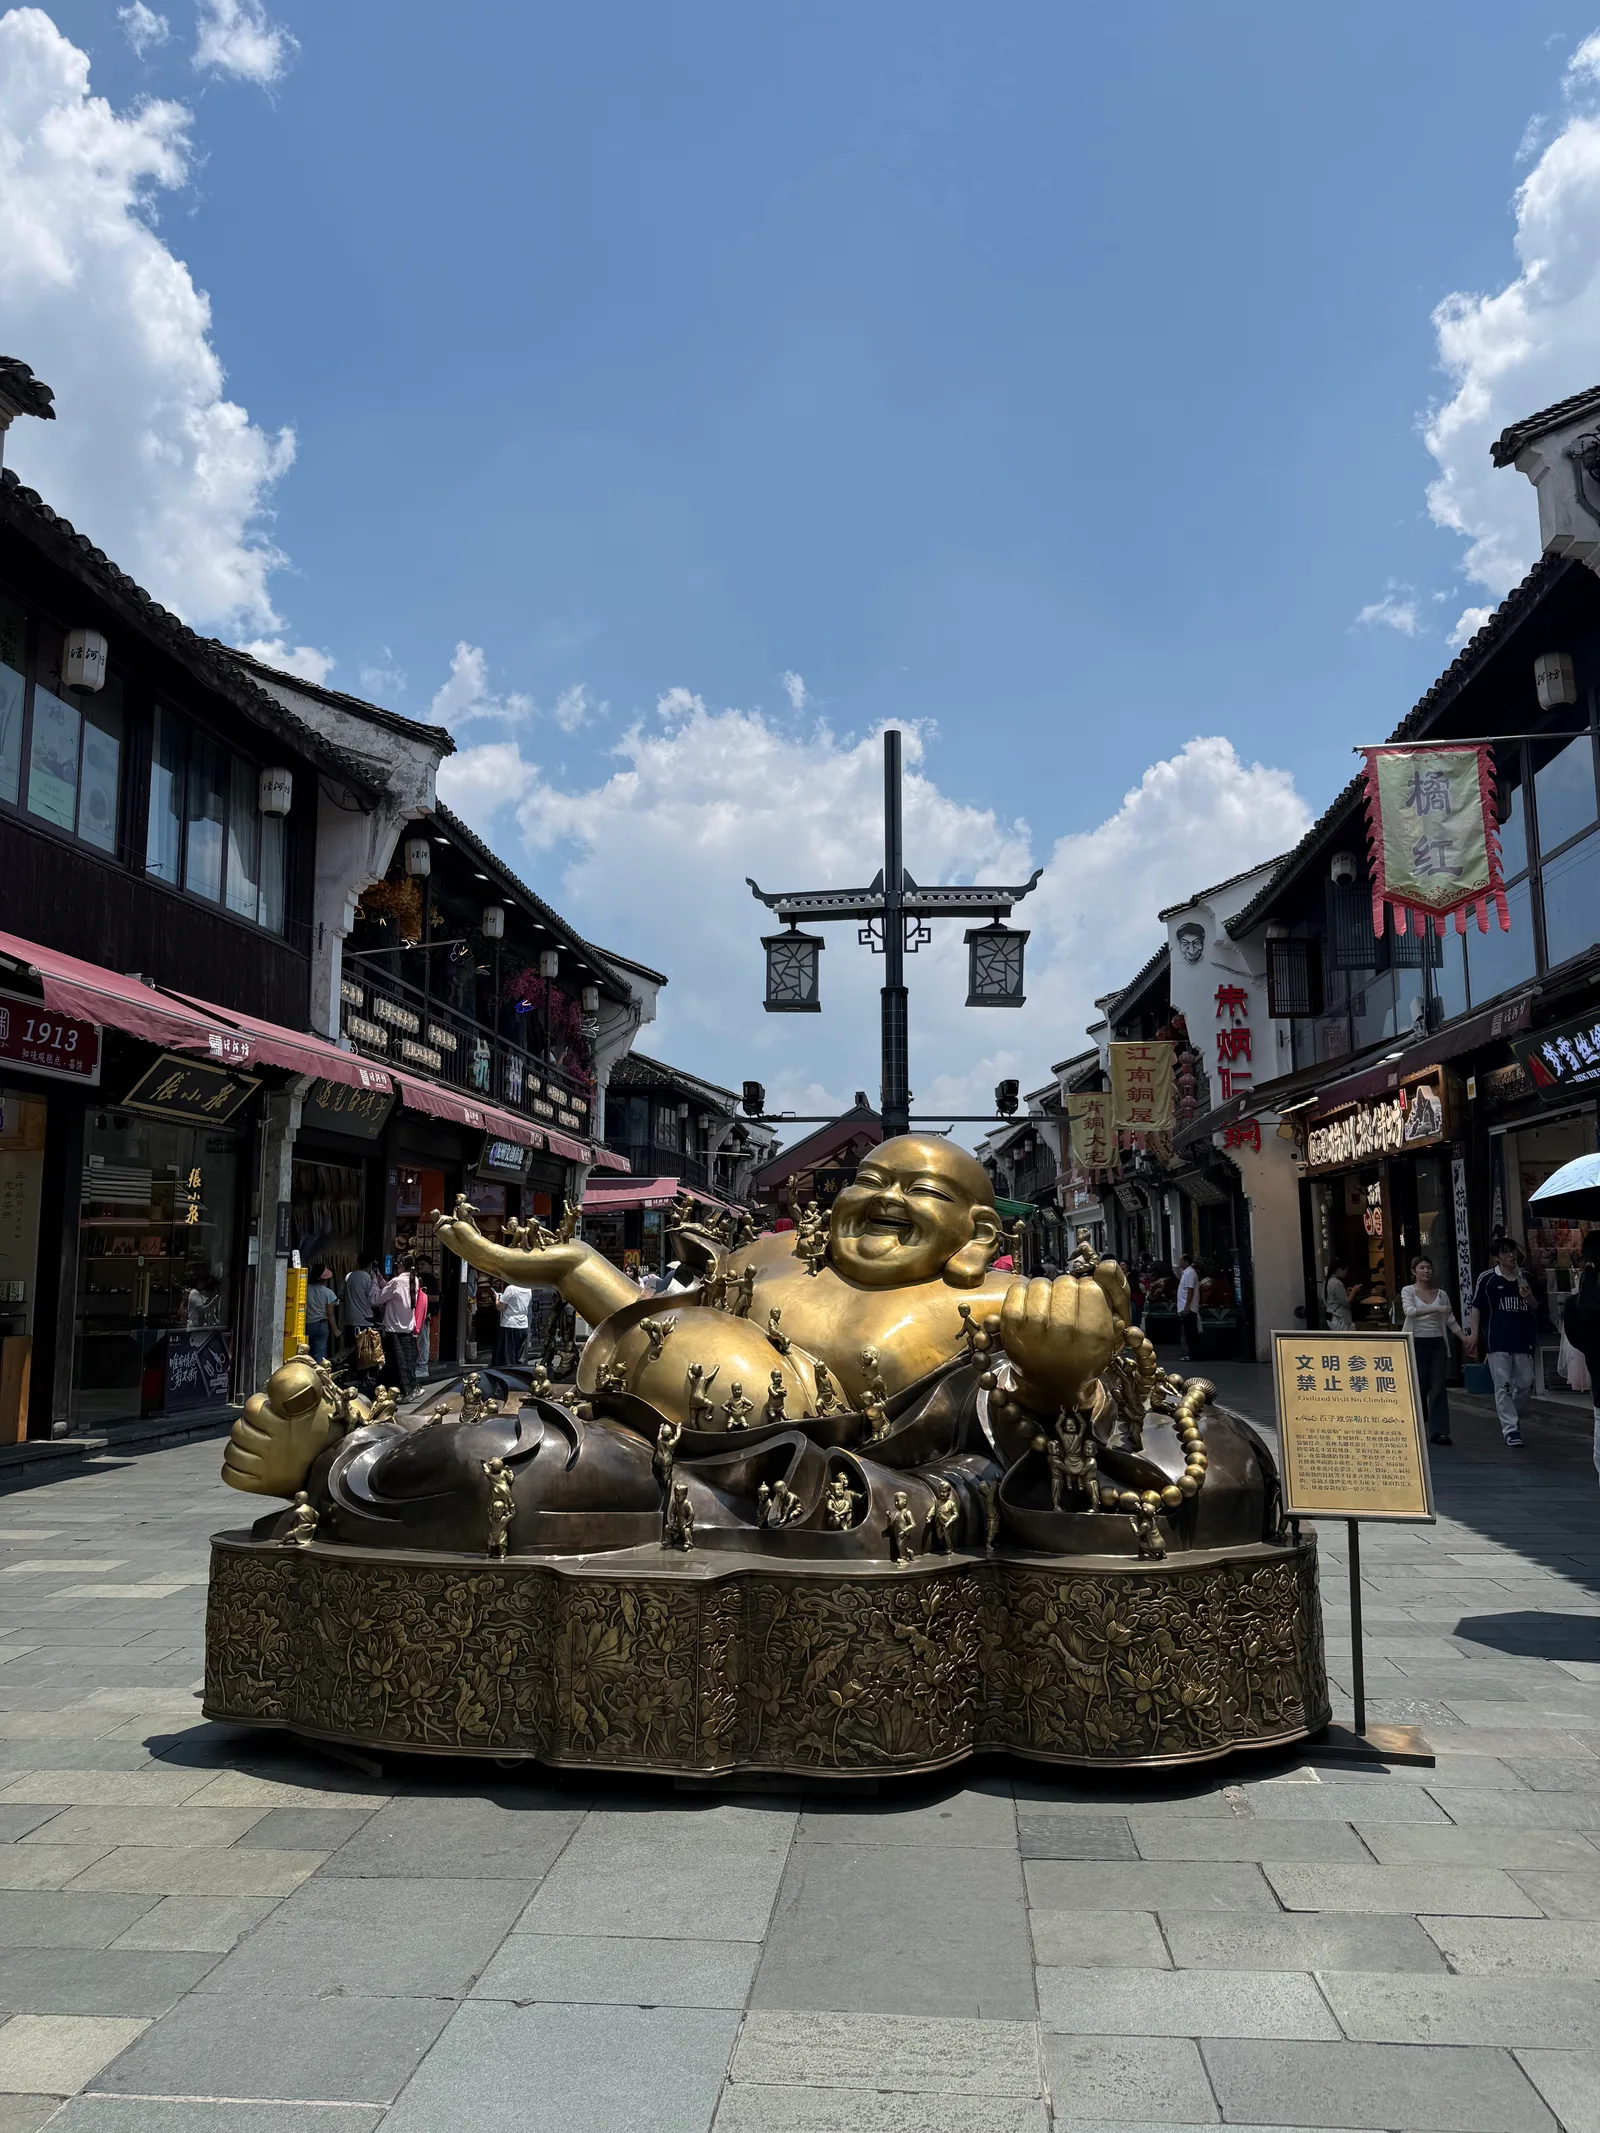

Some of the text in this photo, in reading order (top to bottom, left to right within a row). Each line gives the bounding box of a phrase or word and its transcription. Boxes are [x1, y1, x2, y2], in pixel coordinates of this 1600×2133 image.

[1404, 770, 1464, 877] 橘红
[22, 1019, 79, 1052] 1913
[1125, 1047, 1156, 1124] 江南銅屋
[1081, 1100, 1108, 1164] 青銅大宅
[1295, 1354, 1394, 1373] 文明参观
[1296, 1375, 1396, 1393] 禁止攀爬
[1298, 1396, 1331, 1404] Civilized
[1363, 1396, 1398, 1405] Climbing
[1319, 1414, 1380, 1424] 百子戏弥勒介绍
